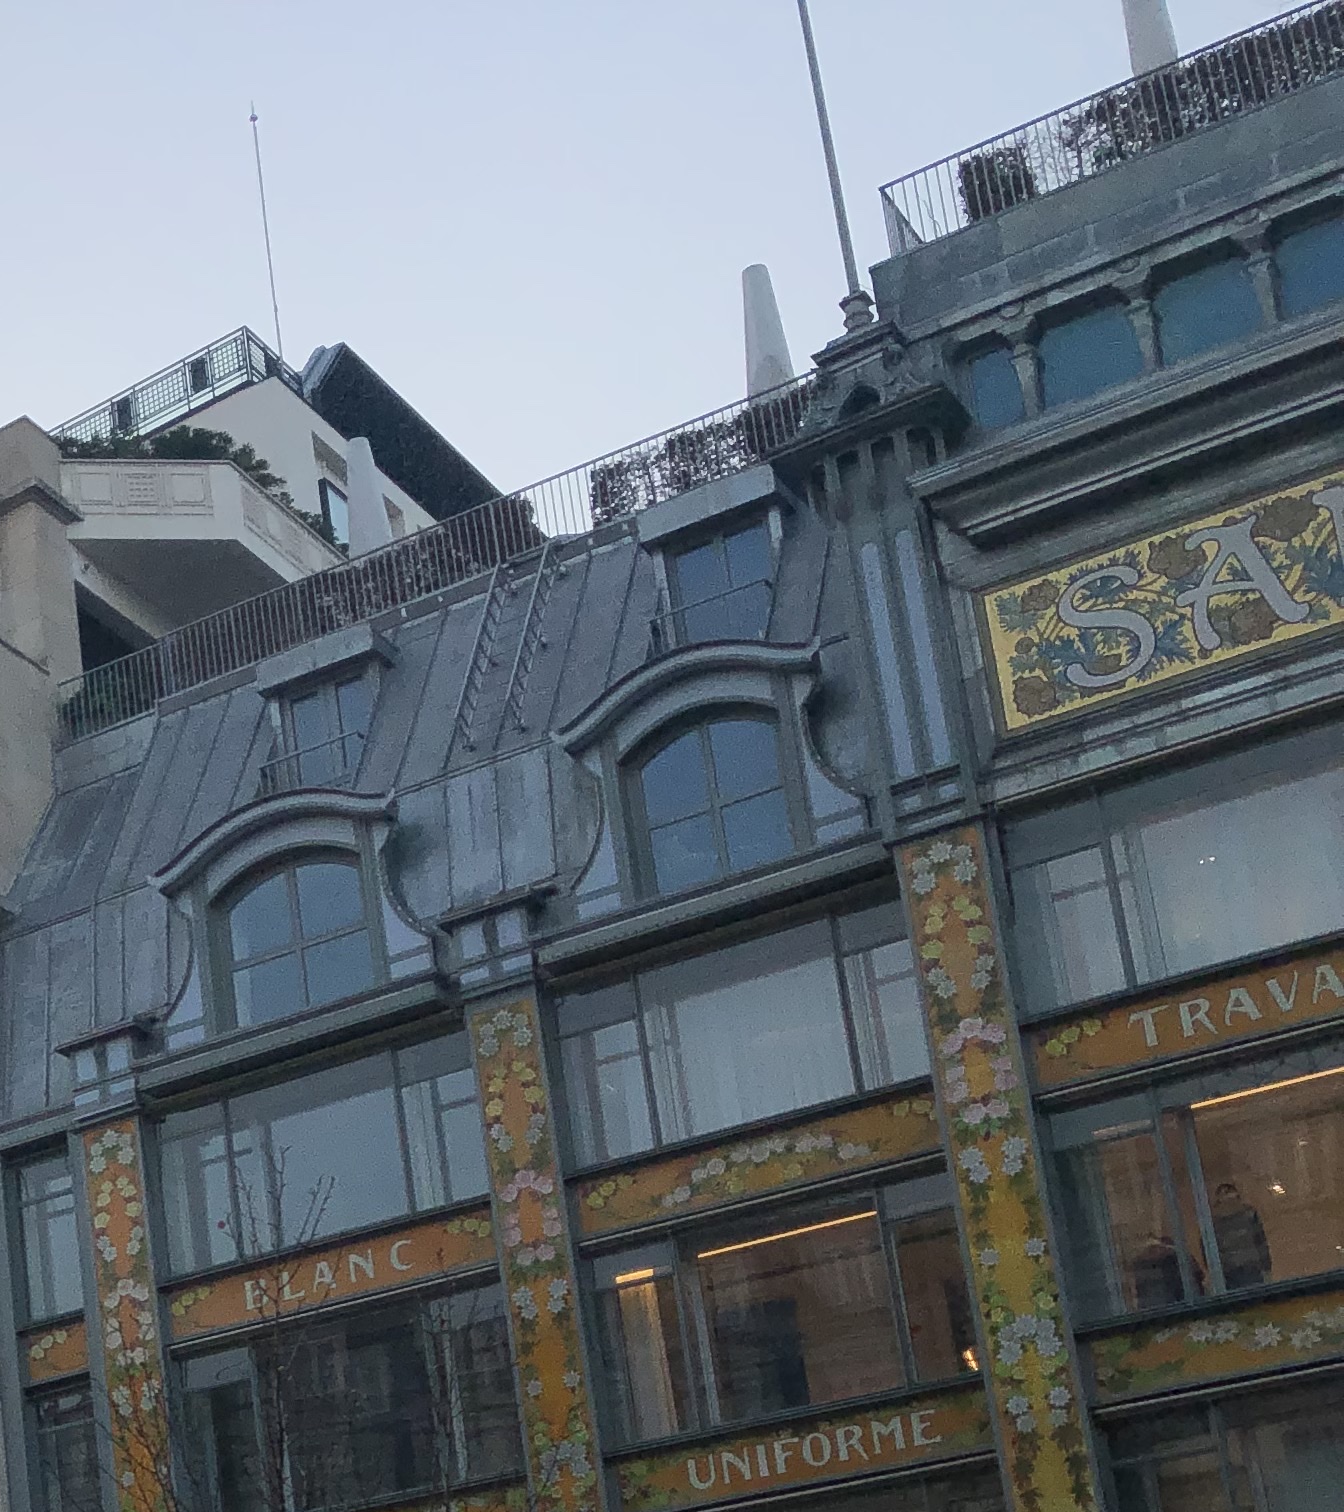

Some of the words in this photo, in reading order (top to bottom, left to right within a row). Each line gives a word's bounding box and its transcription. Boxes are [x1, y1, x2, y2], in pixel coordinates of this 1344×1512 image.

[1127, 963, 1344, 1048] TRAVA
[243, 1239, 416, 1311] BLANC
[687, 1408, 943, 1491] UNIFORME
